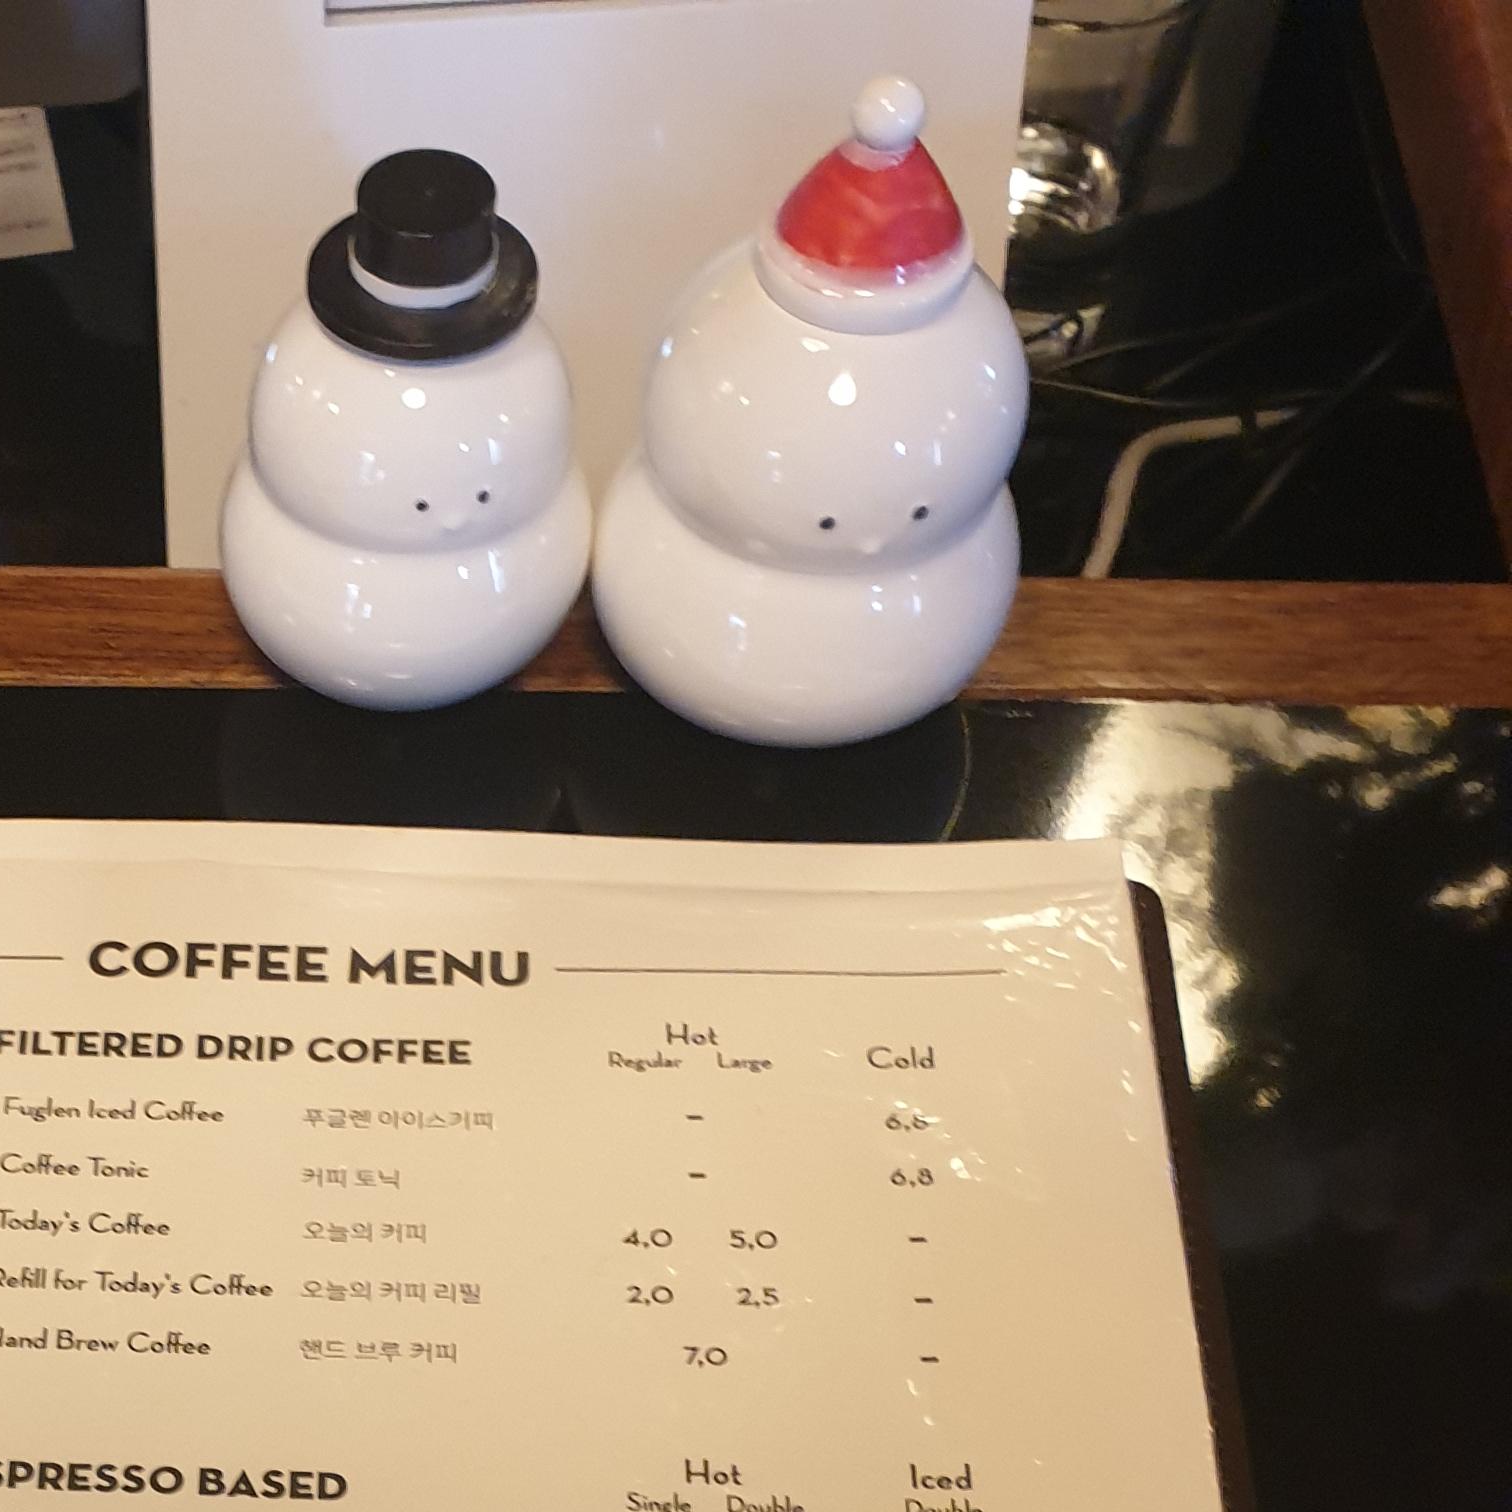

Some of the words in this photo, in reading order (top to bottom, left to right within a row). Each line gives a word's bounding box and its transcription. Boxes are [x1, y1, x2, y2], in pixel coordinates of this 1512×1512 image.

[89, 941, 328, 982] COFFEE
[348, 948, 529, 986] MENU
[666, 1023, 718, 1045] Hot
[197, 1035, 294, 1061] DRIP
[308, 1037, 471, 1065] COFFEE
[867, 1046, 935, 1069] Cold
[608, 1051, 682, 1072] Regular
[717, 1052, 772, 1073] Large
[3, 1096, 80, 1122] Fuglen
[88, 1099, 136, 1119] Iced
[144, 1101, 224, 1122] Coffee
[0, 1153, 80, 1176] Coffee
[87, 1156, 148, 1178] Tonic
[302, 1168, 346, 1188] 커피
[355, 1170, 400, 1189] 토닉
[890, 1168, 933, 1187] 6,8
[89, 1213, 170, 1235] Coffee
[303, 1222, 372, 1243] 오늘의
[381, 1223, 426, 1244] 커피
[623, 1229, 672, 1248] 4,0
[730, 1230, 777, 1250] 5,0
[54, 1269, 88, 1290] for
[190, 1274, 273, 1296] Coffee
[301, 1281, 371, 1301] 오늘의
[380, 1282, 426, 1302] 커피
[434, 1283, 480, 1304] 리필
[627, 1286, 673, 1305] 2,0
[737, 1288, 779, 1307] 2,5
[56, 1329, 119, 1351] Brew
[127, 1331, 210, 1354] Coffee
[355, 1342, 402, 1362] 브루
[410, 1343, 456, 1363] 커피
[683, 1346, 727, 1367] 7,0
[685, 1459, 742, 1485] Hot
[910, 1464, 972, 1490] Iced
[198, 1468, 347, 1500] BASED
